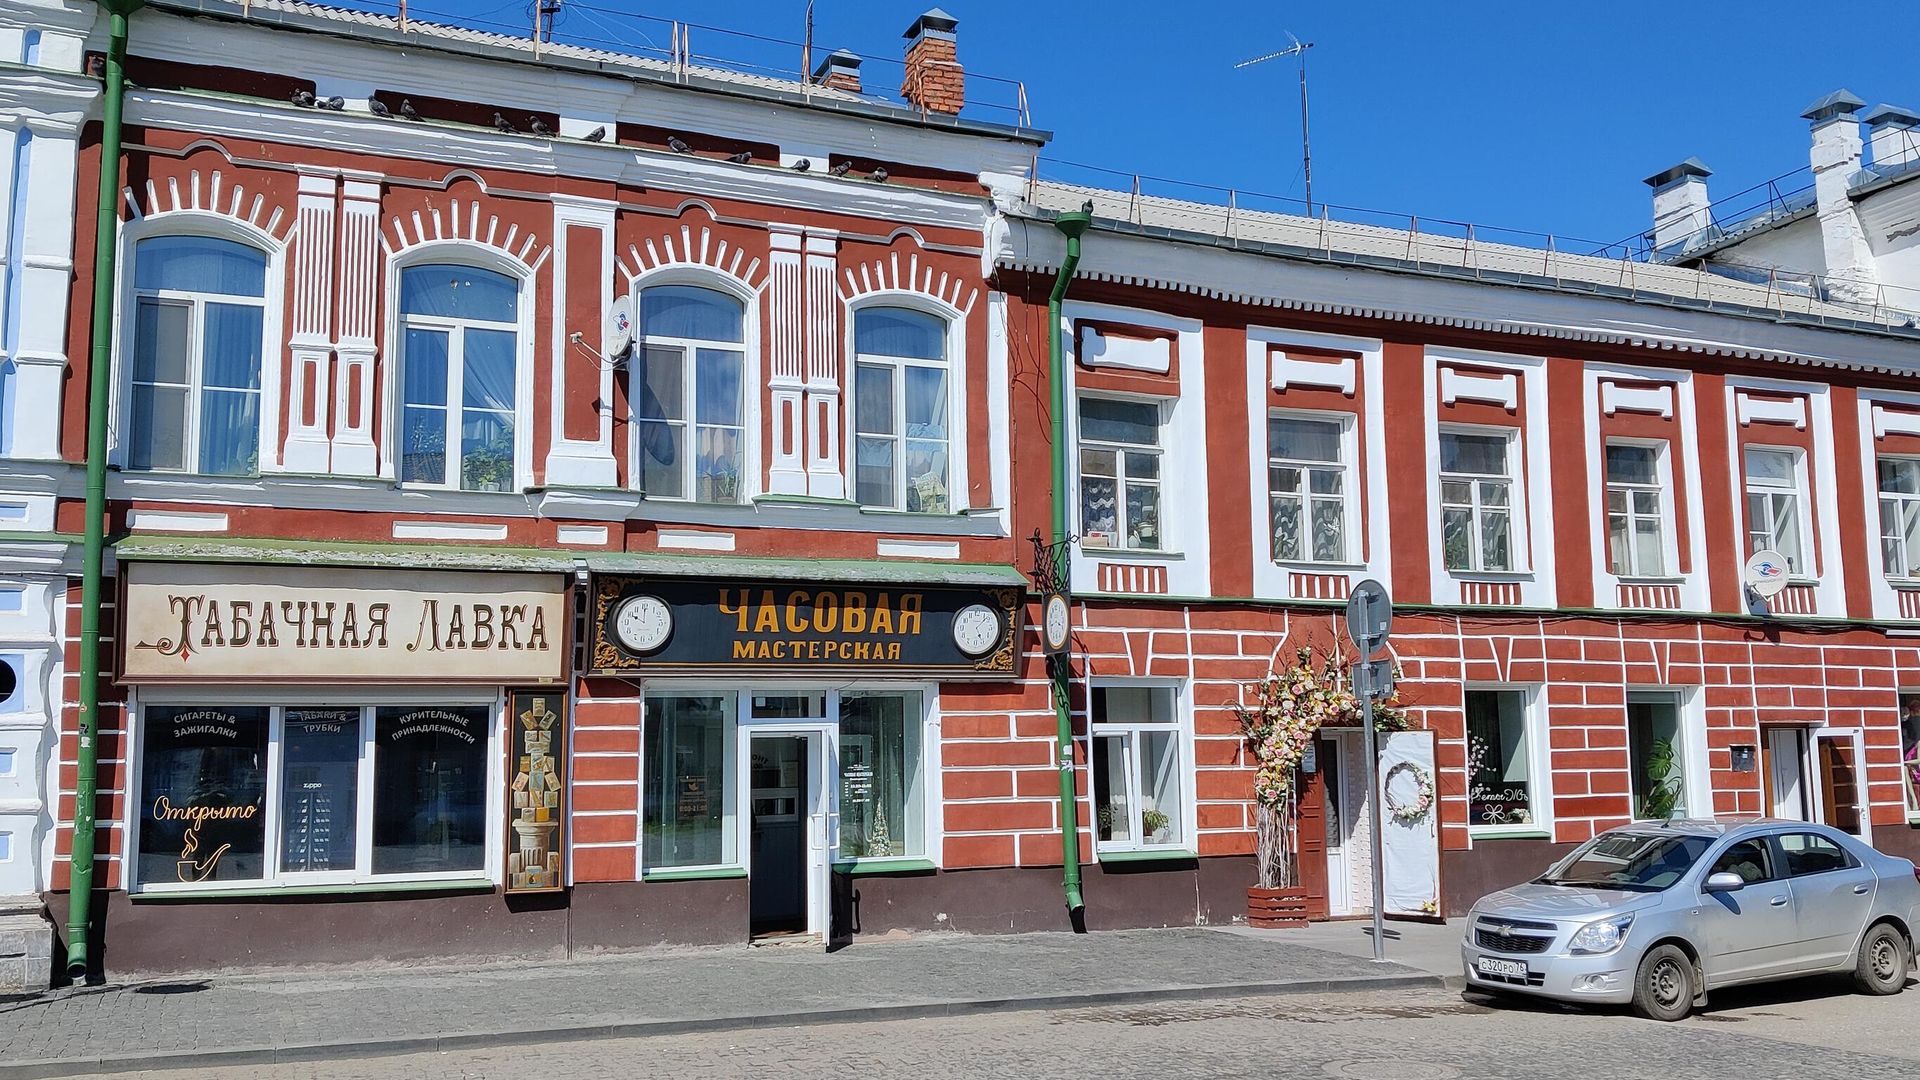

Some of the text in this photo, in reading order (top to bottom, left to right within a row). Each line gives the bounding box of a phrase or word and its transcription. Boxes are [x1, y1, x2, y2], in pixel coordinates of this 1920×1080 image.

[719, 588, 923, 634] ЧАСОВАЯ
[134, 595, 549, 655] ТАБАЧНАЯ ЛАВКА
[732, 640, 902, 660] МАСТЕРСКАЯ
[173, 711, 236, 724] СИГАРЕТЫ &
[399, 710, 470, 727] КУРИТЕЛЬНЫЕ
[173, 725, 238, 739] ЗАЖИГАЛКИ
[303, 724, 341, 733] ТРУБКИ
[391, 724, 475, 744] ПРИНАДЛЕЖНОСТИ
[153, 795, 258, 831] Открыто
